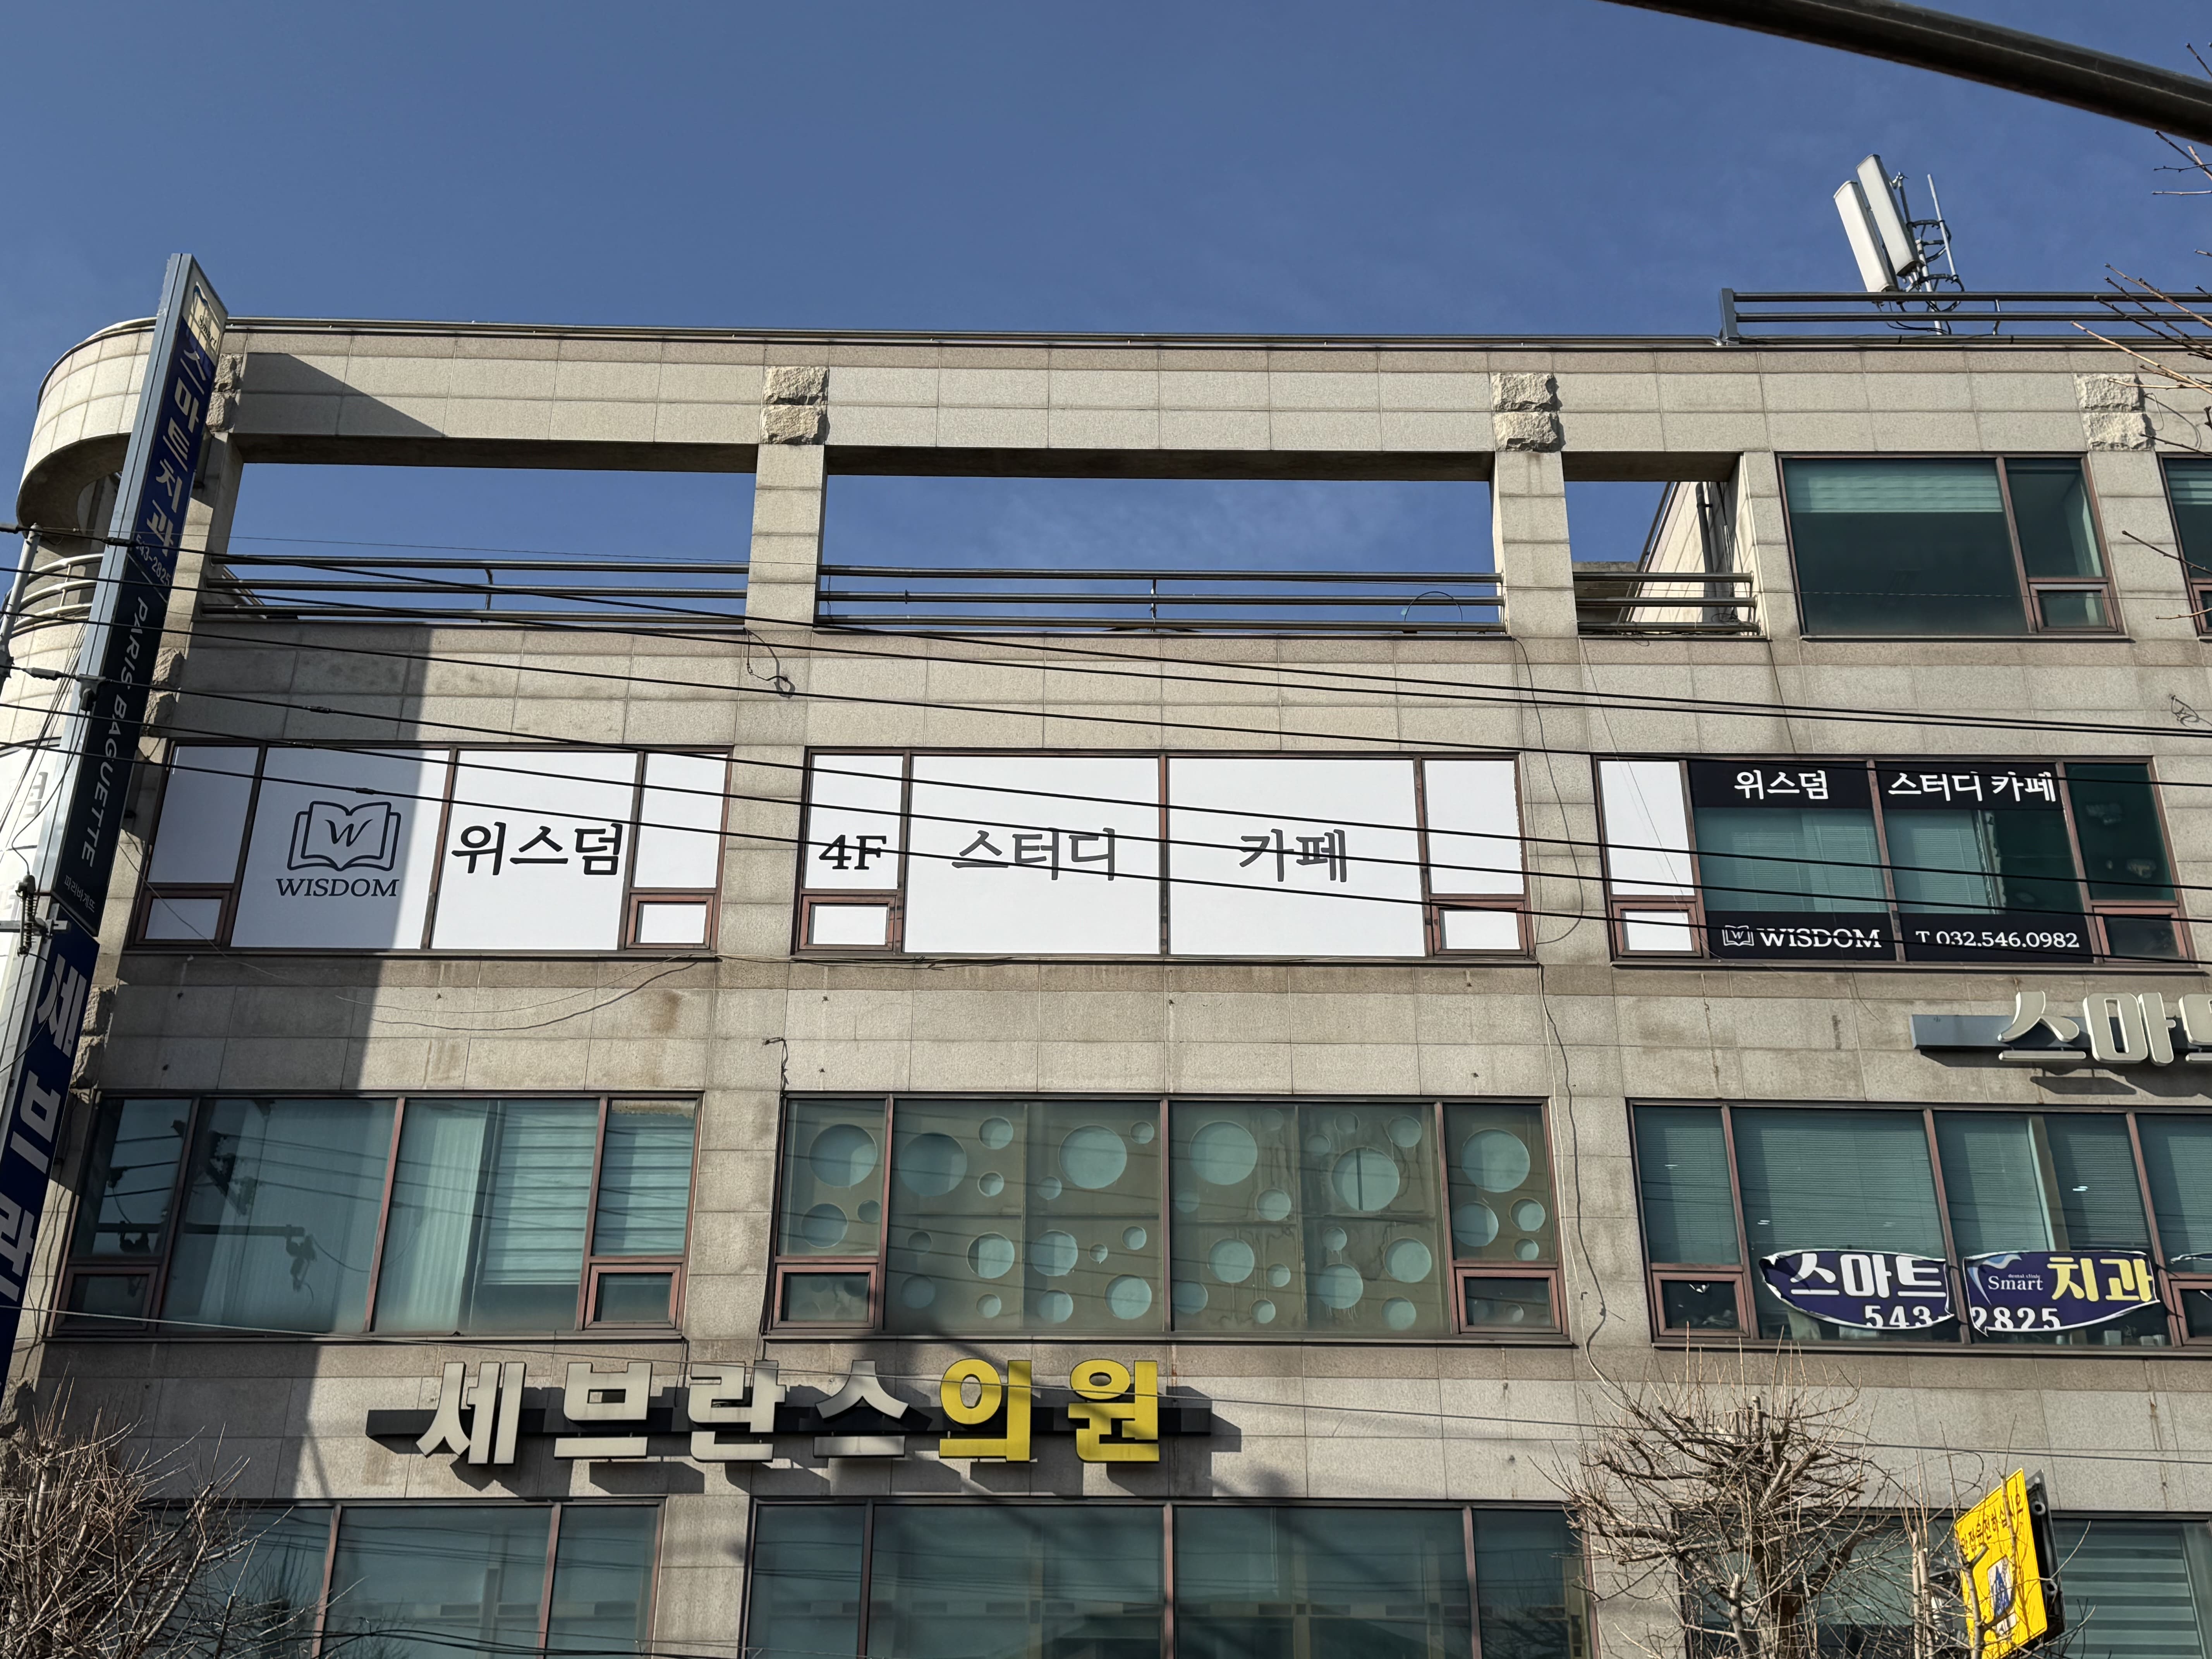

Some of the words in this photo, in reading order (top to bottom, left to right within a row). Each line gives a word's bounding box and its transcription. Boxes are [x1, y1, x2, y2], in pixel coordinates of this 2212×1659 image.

[147, 350, 206, 557] 스마트치과
[121, 597, 148, 690] PARIS
[82, 694, 127, 867] BAGUETTE
[1734, 769, 1829, 799] 위스덤
[1888, 771, 1982, 801] 스터디
[1991, 771, 2056, 802] 카페
[451, 822, 623, 876] 위스덤
[818, 835, 887, 870] 4F
[951, 828, 1117, 881] 스터디
[1239, 829, 1348, 883] 카페
[64, 875, 95, 913] 파리바게뜨
[276, 878, 400, 897] WISDOM
[1756, 928, 1882, 948] WISDOM
[1915, 931, 1930, 944] T
[1936, 931, 2080, 948] 032.546.0982
[1790, 1253, 1946, 1298] 스마트
[1988, 1275, 2044, 1290] Smart
[2047, 1257, 2152, 1302] 치과
[1972, 1307, 2061, 1329] 2825
[415, 1358, 1160, 1465] 세브란스의원
